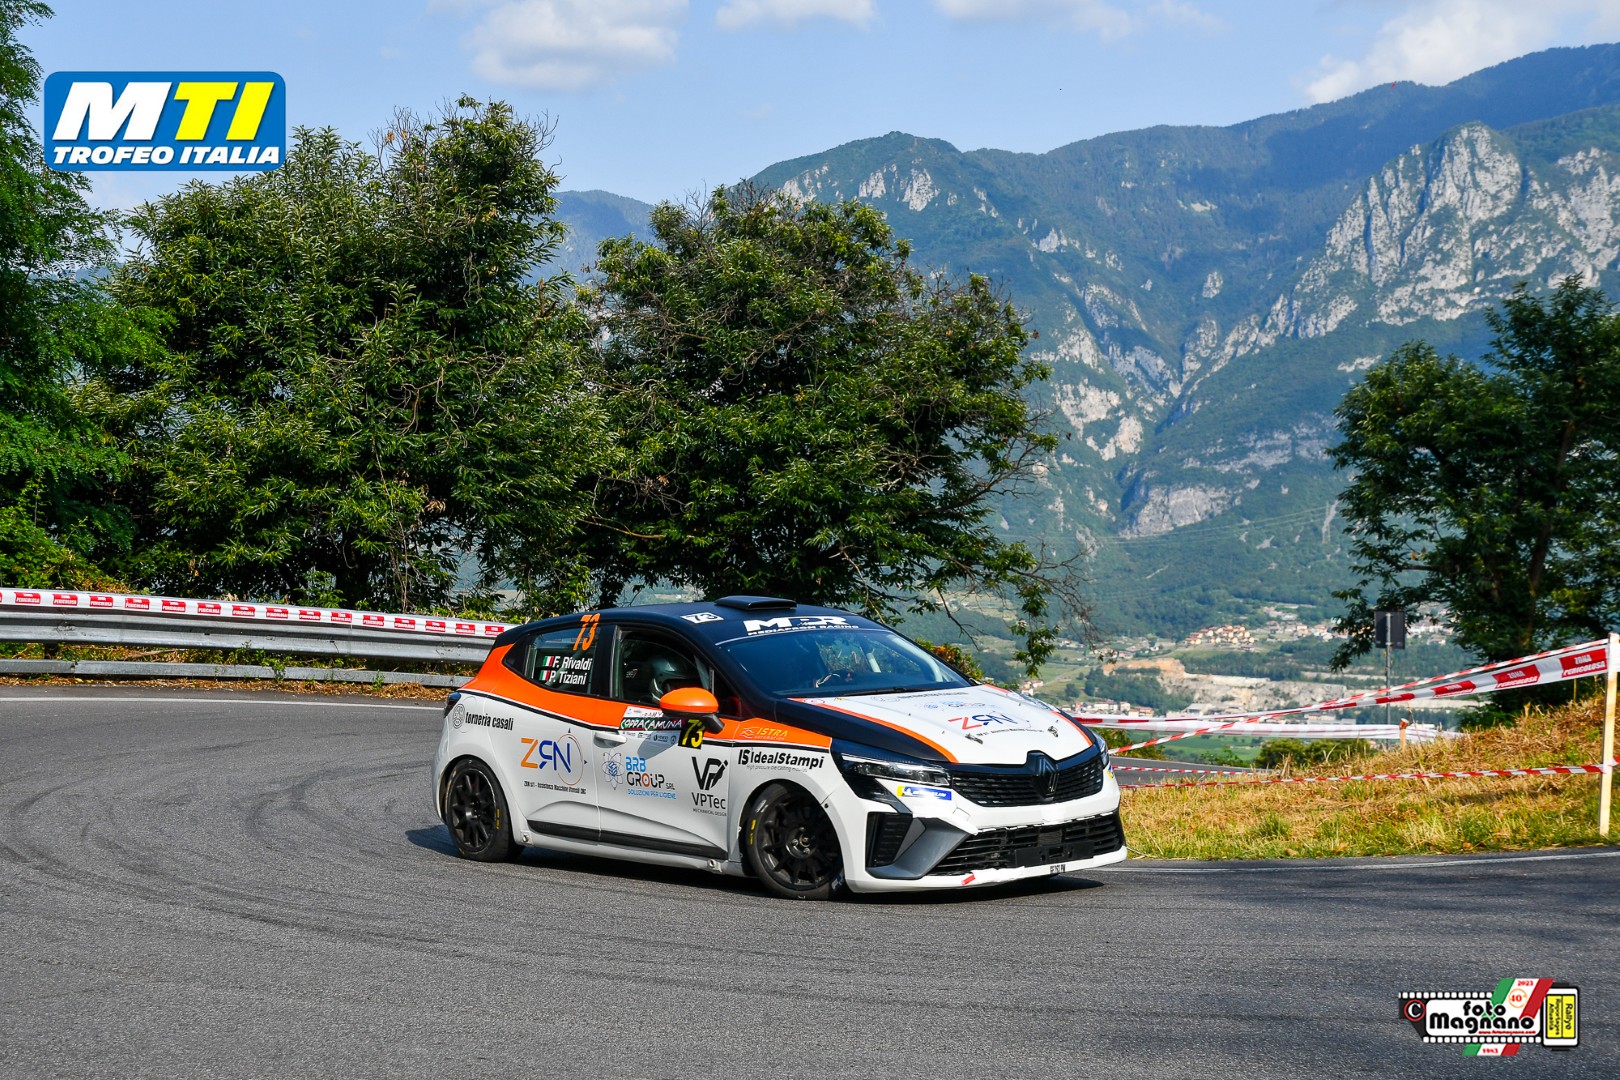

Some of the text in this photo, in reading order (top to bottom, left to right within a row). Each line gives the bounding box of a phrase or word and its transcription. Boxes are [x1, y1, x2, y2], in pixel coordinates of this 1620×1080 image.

[686, 613, 718, 622] 73
[573, 613, 600, 650] 73
[552, 656, 592, 670] F. Rivaldi
[1574, 654, 1592, 664] ZONA
[1563, 660, 1606, 676] PERICOLOSA
[549, 670, 587, 685] P. Tiziani
[465, 712, 514, 731] torneria casali
[682, 719, 705, 748] 73
[757, 728, 788, 737] ISTRA
[626, 756, 646, 772] BRB
[750, 752, 824, 769] IdealStampi
[627, 772, 665, 788] GROUP
[691, 792, 726, 810] VPTec
